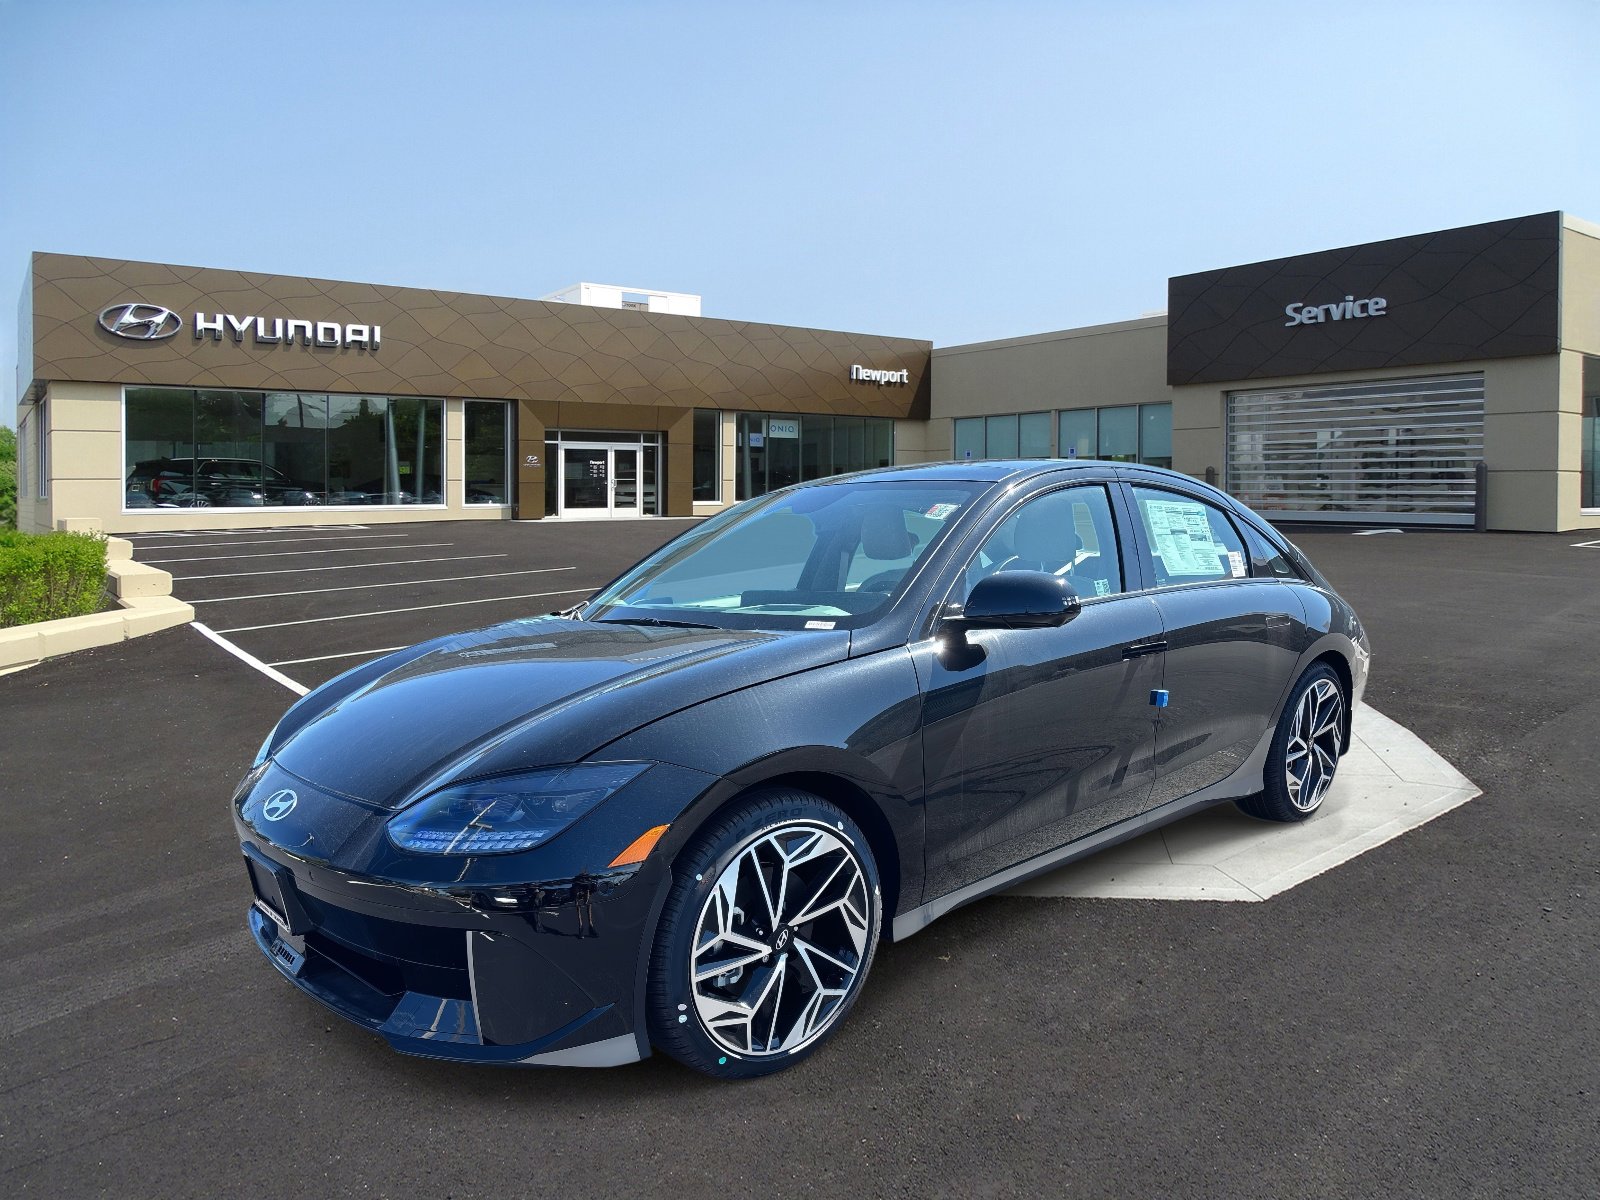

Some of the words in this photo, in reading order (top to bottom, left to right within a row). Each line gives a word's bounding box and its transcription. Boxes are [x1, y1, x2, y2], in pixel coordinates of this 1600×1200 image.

[1285, 295, 1387, 327] Service
[195, 312, 381, 351] HYUNDAI
[850, 364, 909, 385] Newport
[770, 424, 795, 433] ONIQ
